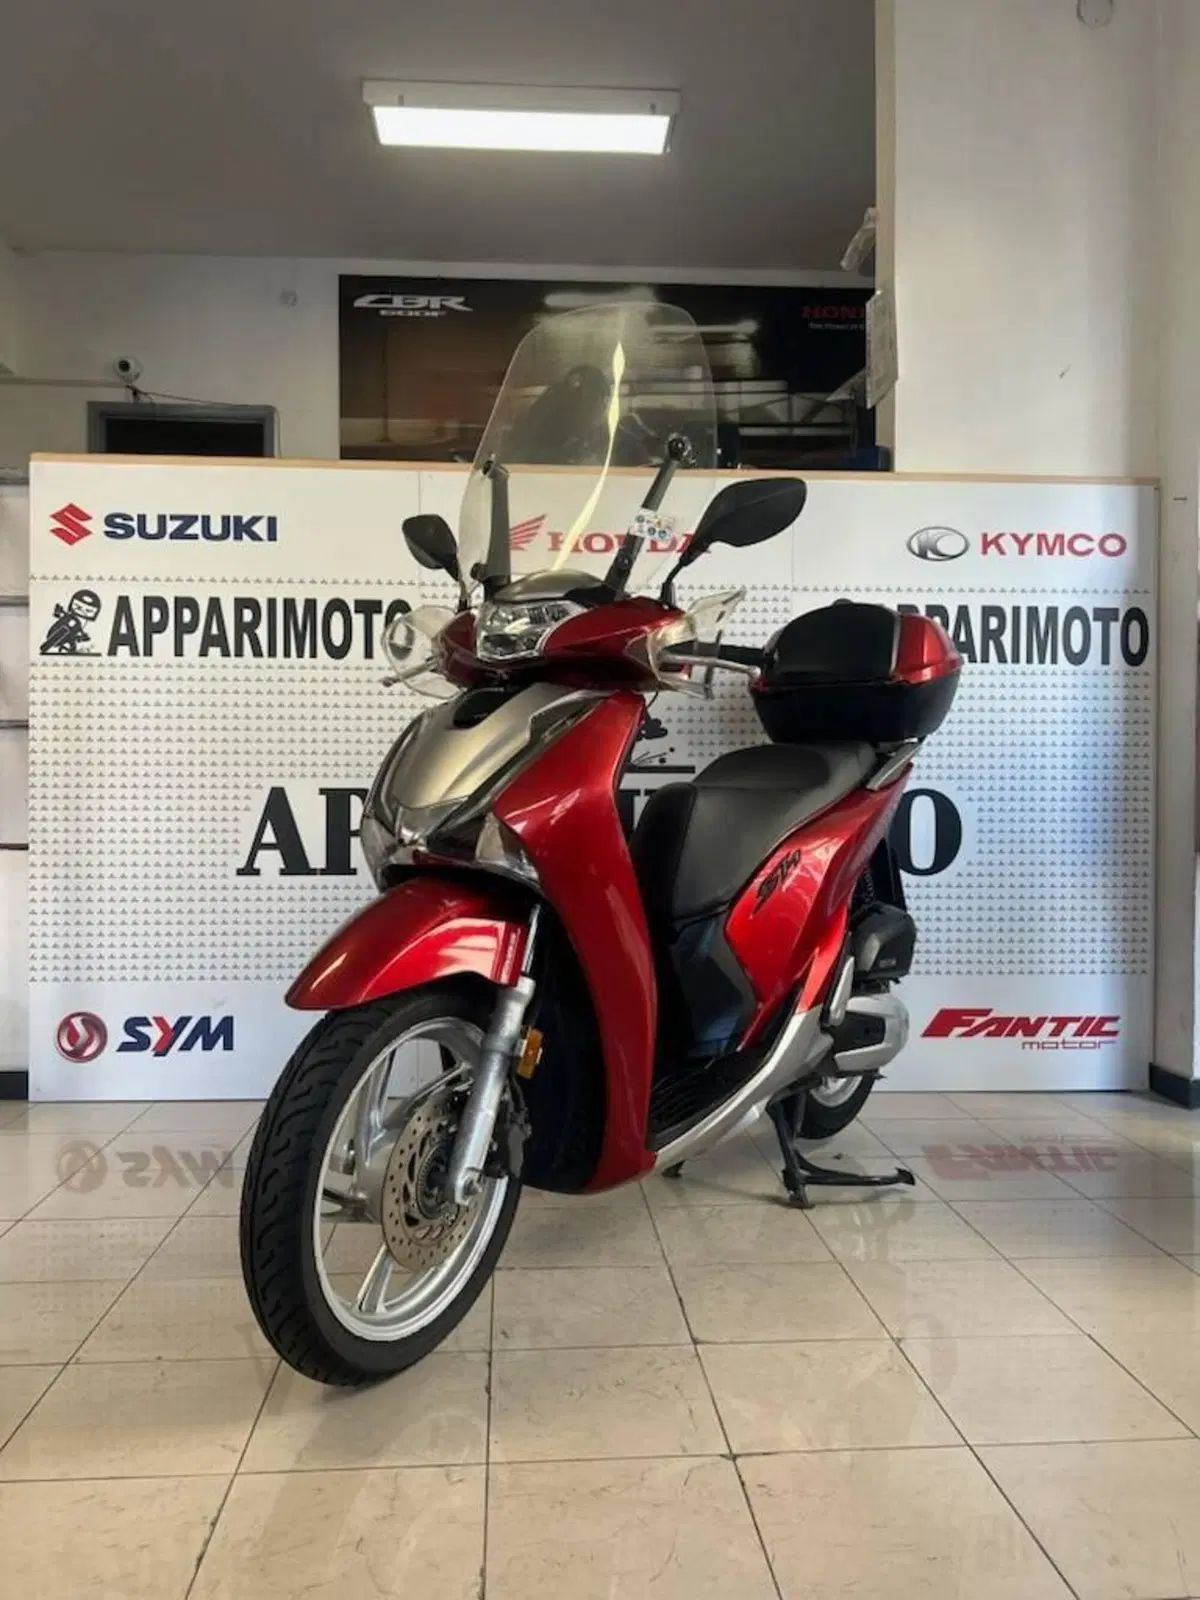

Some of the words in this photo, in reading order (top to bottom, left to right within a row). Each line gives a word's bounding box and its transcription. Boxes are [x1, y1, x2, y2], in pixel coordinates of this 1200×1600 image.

[353, 294, 474, 312] CBR
[104, 513, 278, 542] SUZUKI
[980, 532, 1128, 557] KYMCO
[107, 595, 415, 661] APPARIMOTO
[116, 1016, 234, 1057] SYM
[920, 1008, 1120, 1037] FANTIC
[1021, 1039, 1116, 1050] motor
